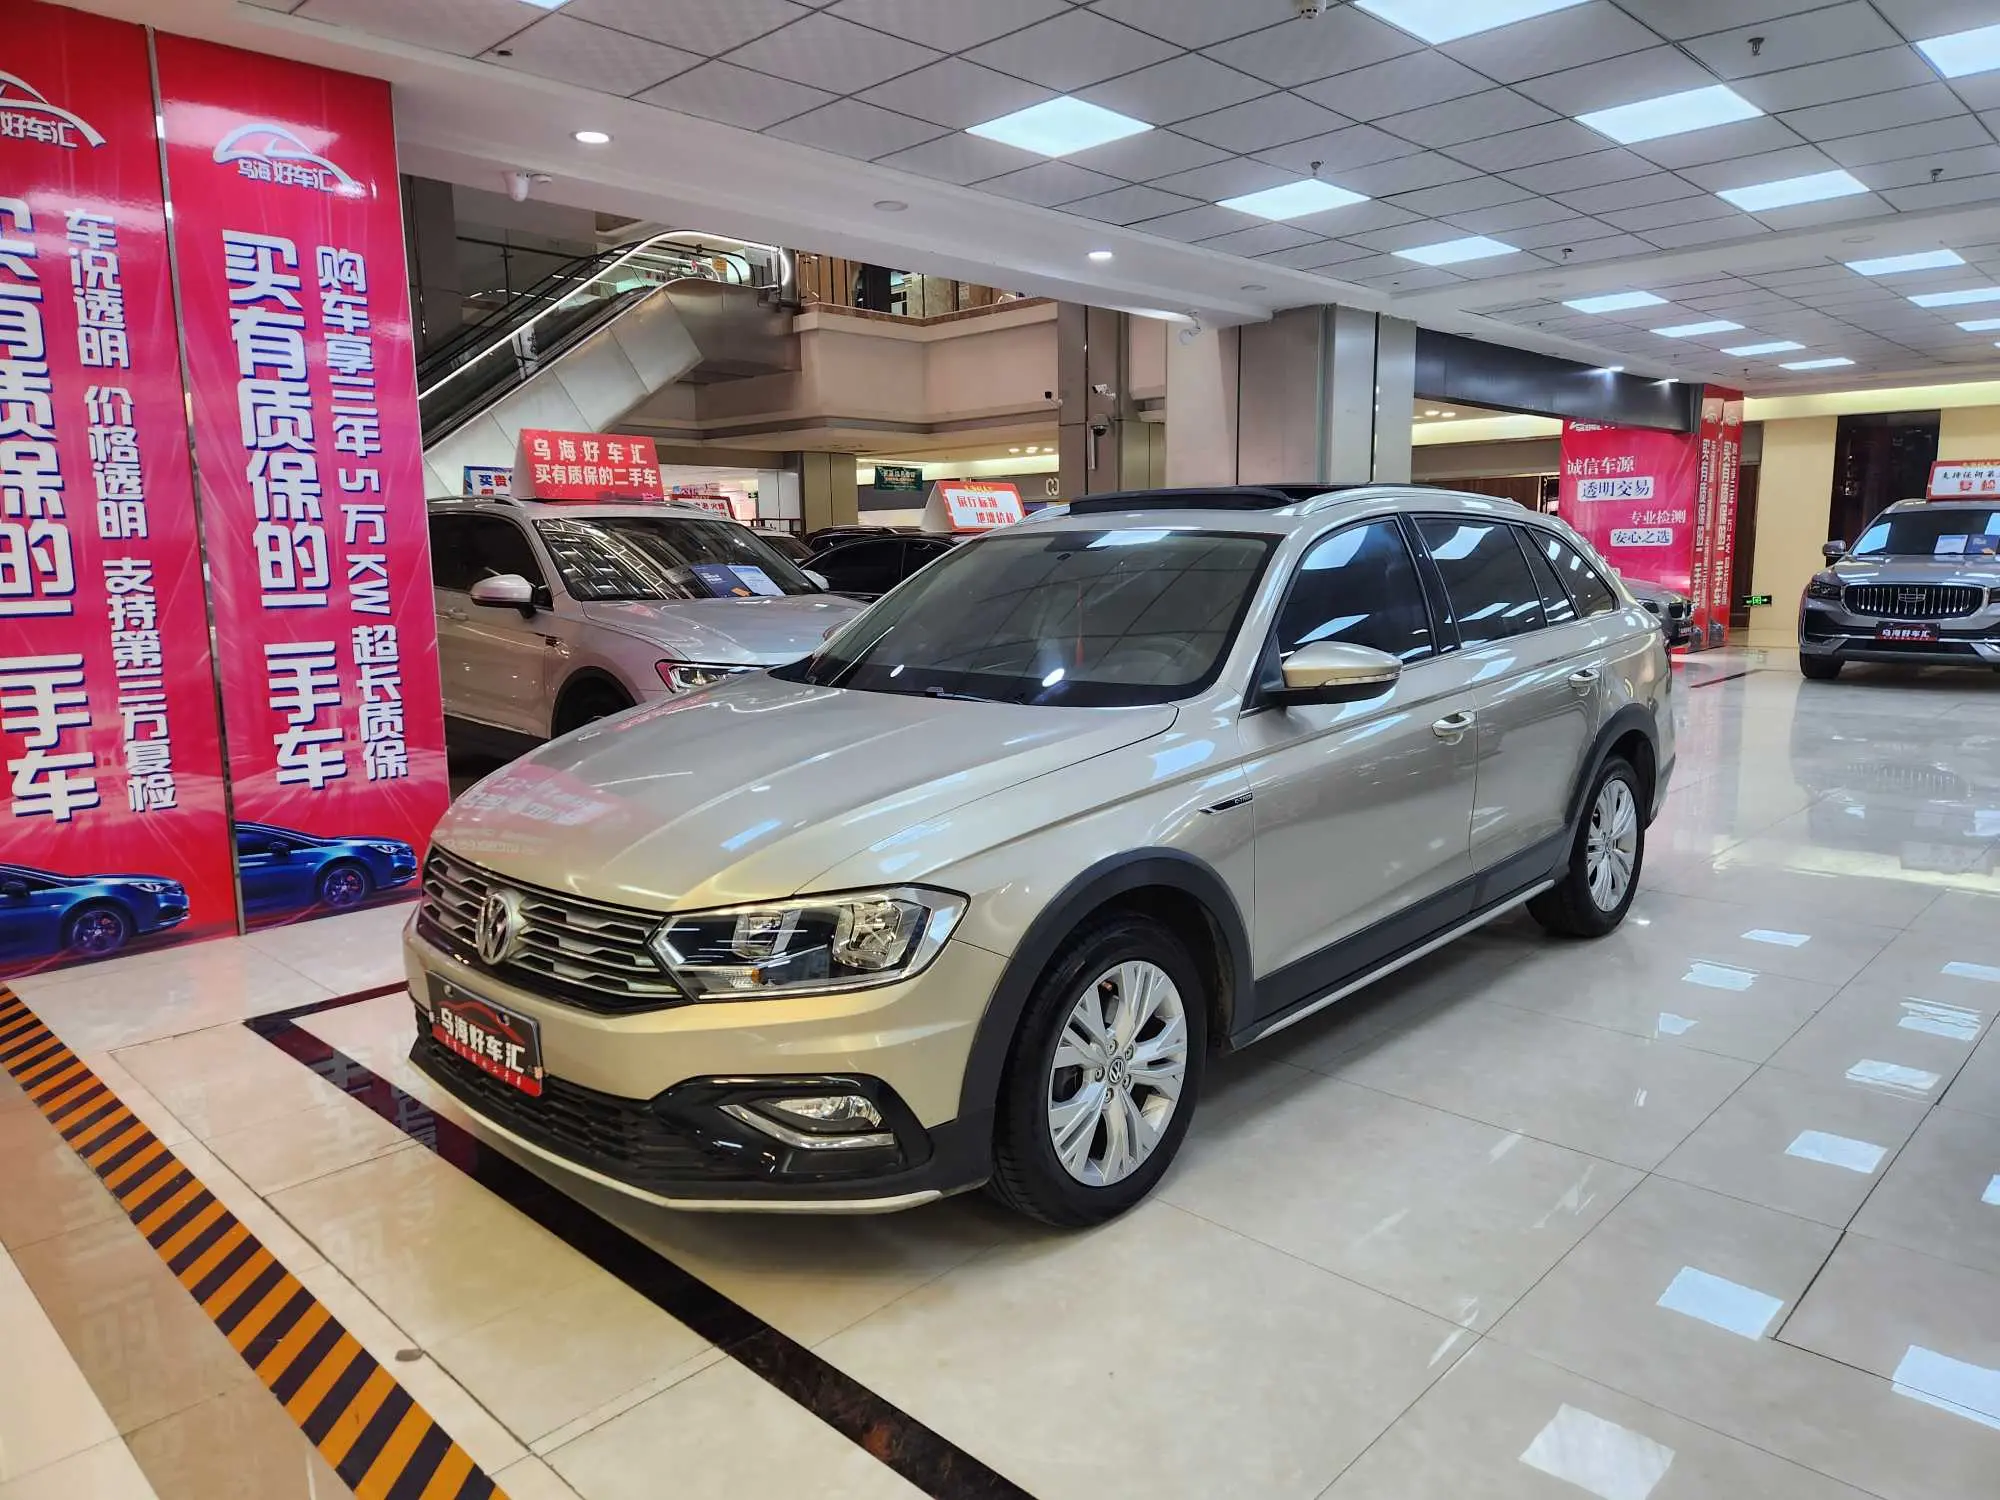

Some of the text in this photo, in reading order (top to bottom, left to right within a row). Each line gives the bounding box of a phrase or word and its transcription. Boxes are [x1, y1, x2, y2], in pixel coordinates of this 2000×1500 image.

[533, 438, 648, 465] 乌海好车汇
[535, 464, 658, 488] 买有质保的二手车
[1567, 456, 1635, 475] 诚信车源
[1582, 479, 1650, 499] 透明交易
[64, 207, 178, 813] 车况透明 价格透明 支持第三方复检
[222, 229, 347, 790] 买有质保的二手车
[1631, 509, 1687, 525] 专业检测
[1613, 529, 1670, 544] 安心之选
[440, 1007, 526, 1074] 乌海好车汇
